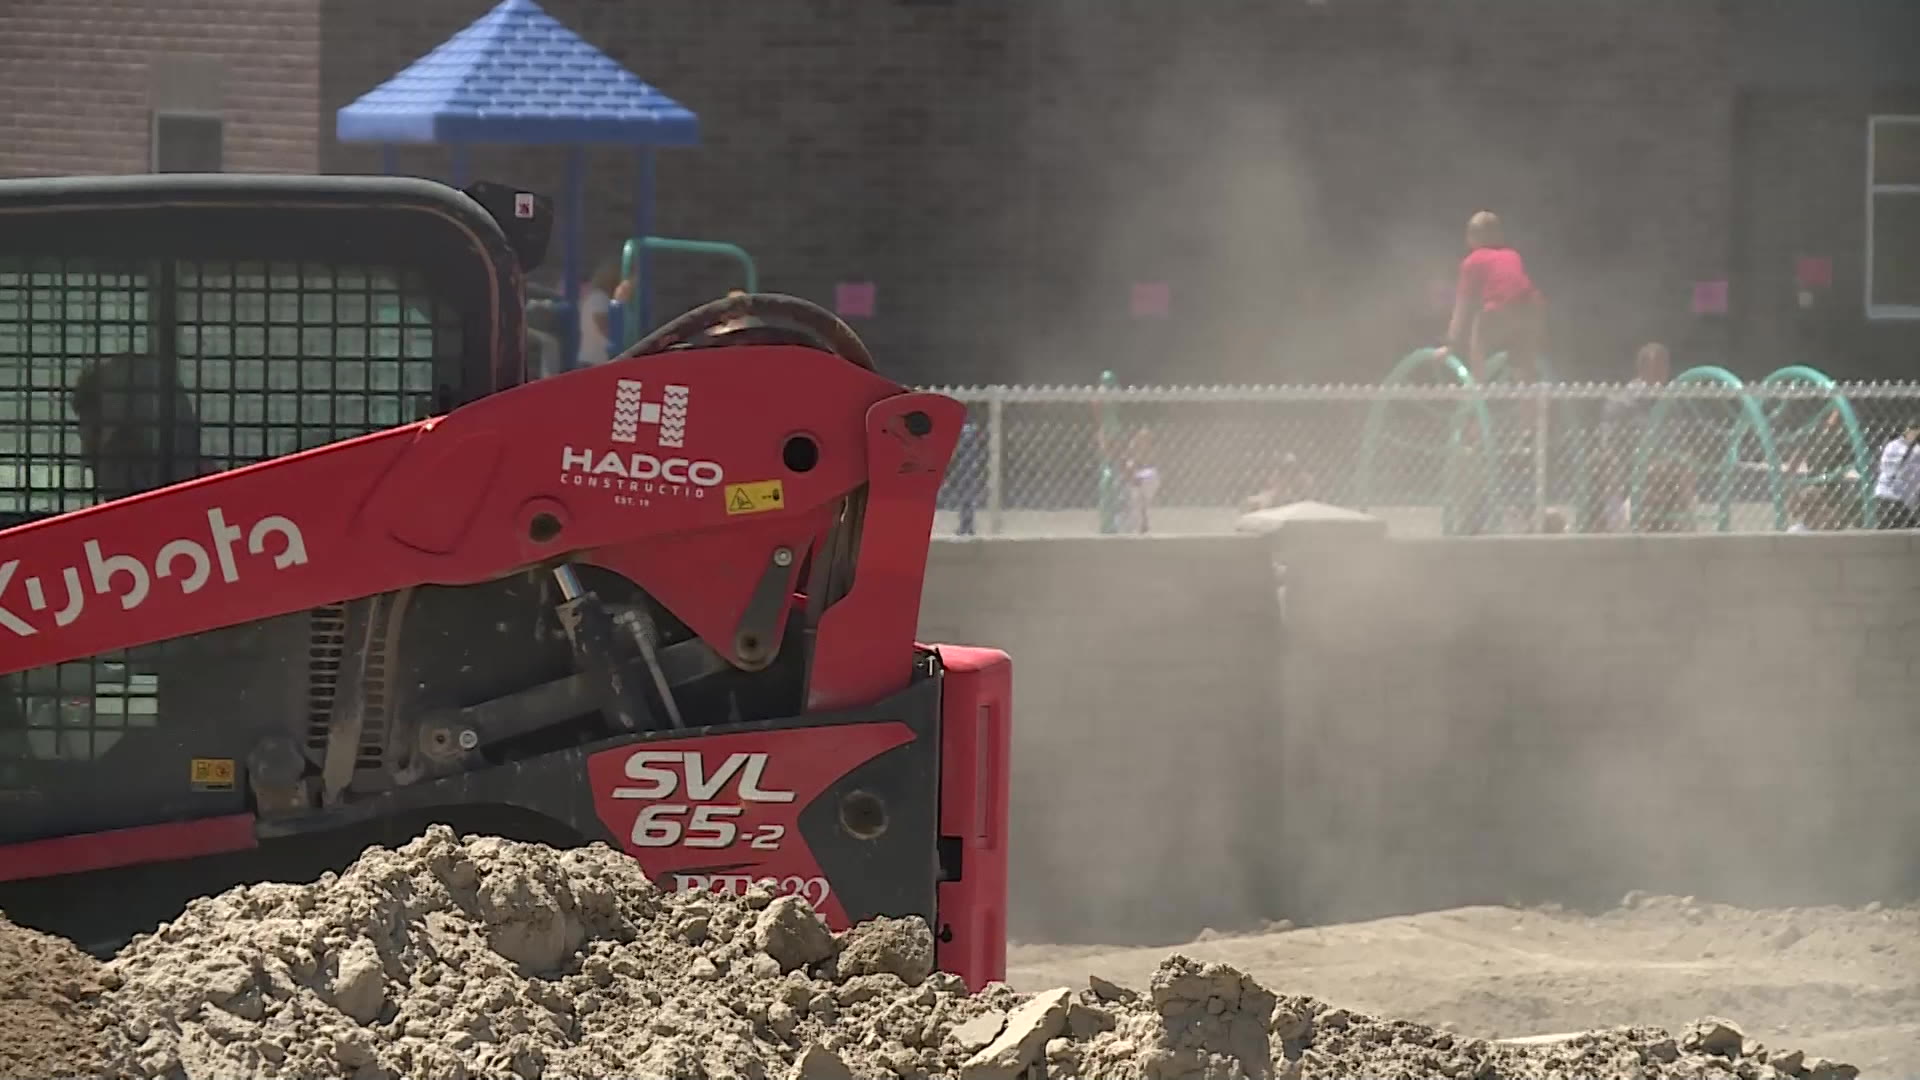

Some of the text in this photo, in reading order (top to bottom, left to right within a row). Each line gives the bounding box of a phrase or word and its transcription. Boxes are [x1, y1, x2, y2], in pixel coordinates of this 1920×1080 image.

[560, 473, 705, 498] CONSTRUCTIO
[561, 446, 725, 487] HADCO
[614, 494, 635, 506] EST.
[611, 751, 796, 802] SVL
[631, 803, 786, 850] 65-2
